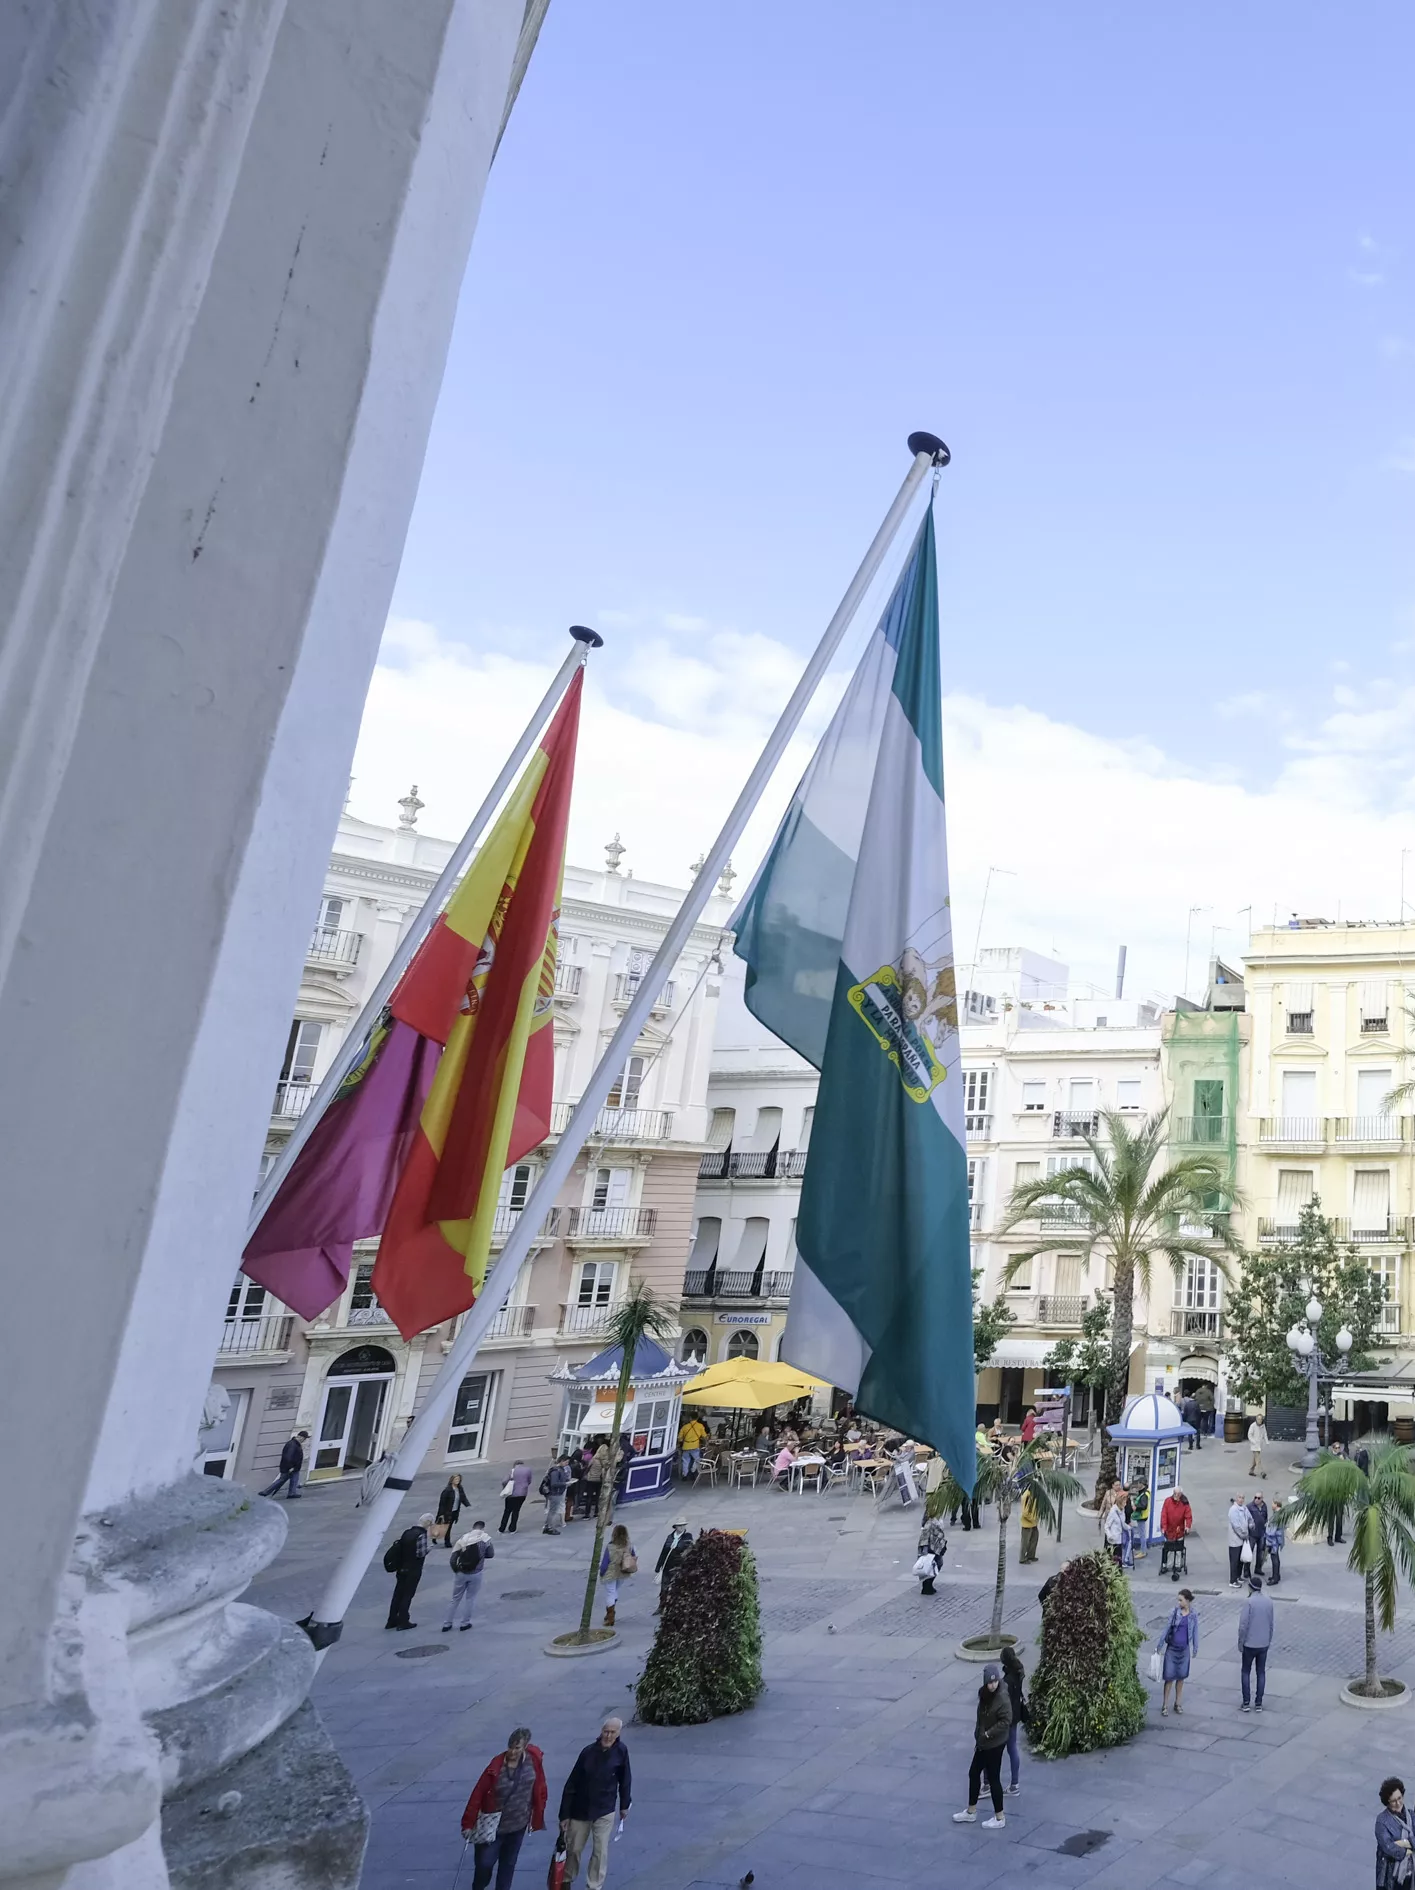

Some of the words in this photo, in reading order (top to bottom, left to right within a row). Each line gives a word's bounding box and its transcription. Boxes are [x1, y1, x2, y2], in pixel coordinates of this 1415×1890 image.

[863, 996, 873, 1009] Y
[870, 1010, 883, 1026] LA
[881, 1005, 902, 1033] PARA
[986, 1358, 1000, 1366] BAR
